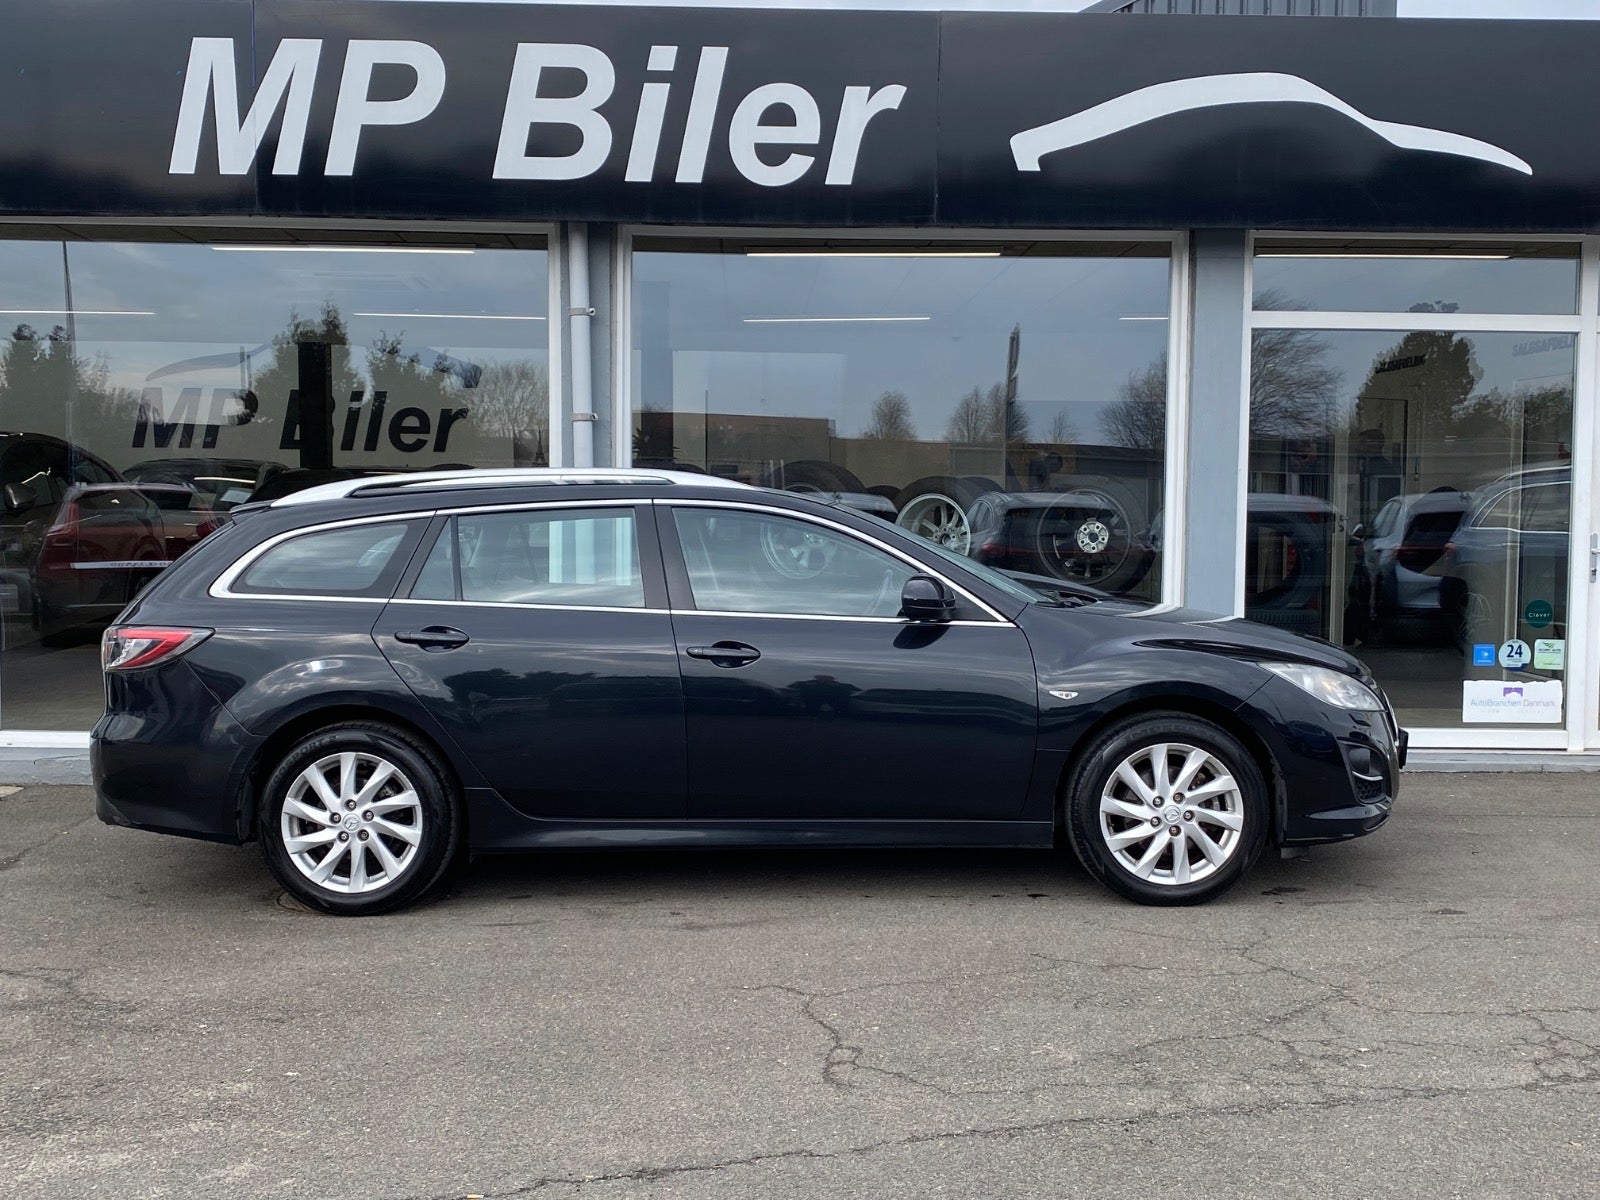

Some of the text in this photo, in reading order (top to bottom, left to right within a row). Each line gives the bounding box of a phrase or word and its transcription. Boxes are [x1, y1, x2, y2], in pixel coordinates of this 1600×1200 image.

[168, 36, 908, 187] MP Biler
[131, 387, 259, 448] MP
[1506, 644, 1523, 658] 24
[1470, 699, 1555, 707] AutoBranchen Danmark
